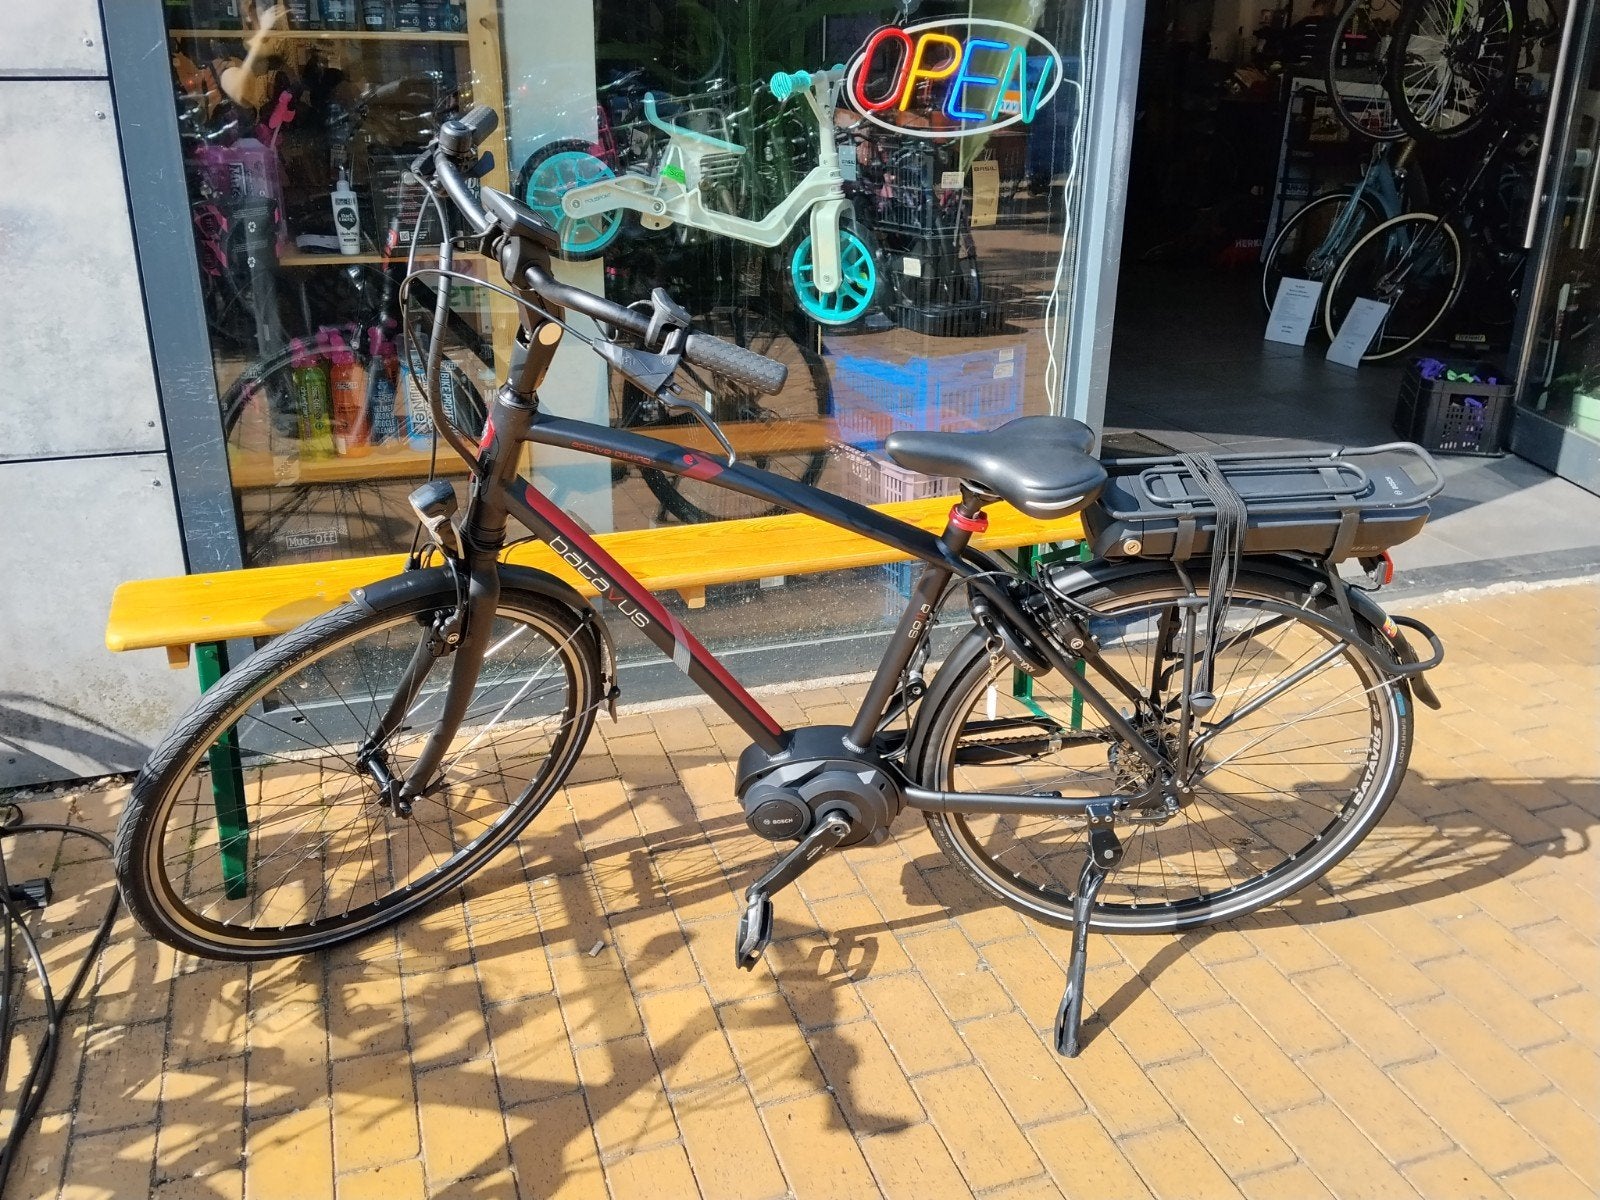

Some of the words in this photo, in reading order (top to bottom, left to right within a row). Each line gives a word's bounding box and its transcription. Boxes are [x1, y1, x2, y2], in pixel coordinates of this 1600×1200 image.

[855, 27, 1055, 124] OPEN
[442, 371, 453, 395] BIKE
[571, 441, 612, 455] active
[549, 535, 650, 628] batavus
[1019, 660, 1036, 673] AXA
[1398, 717, 1407, 764] MARATHON
[1353, 725, 1383, 806] BATAVUS
[772, 818, 794, 826] BOSCH
